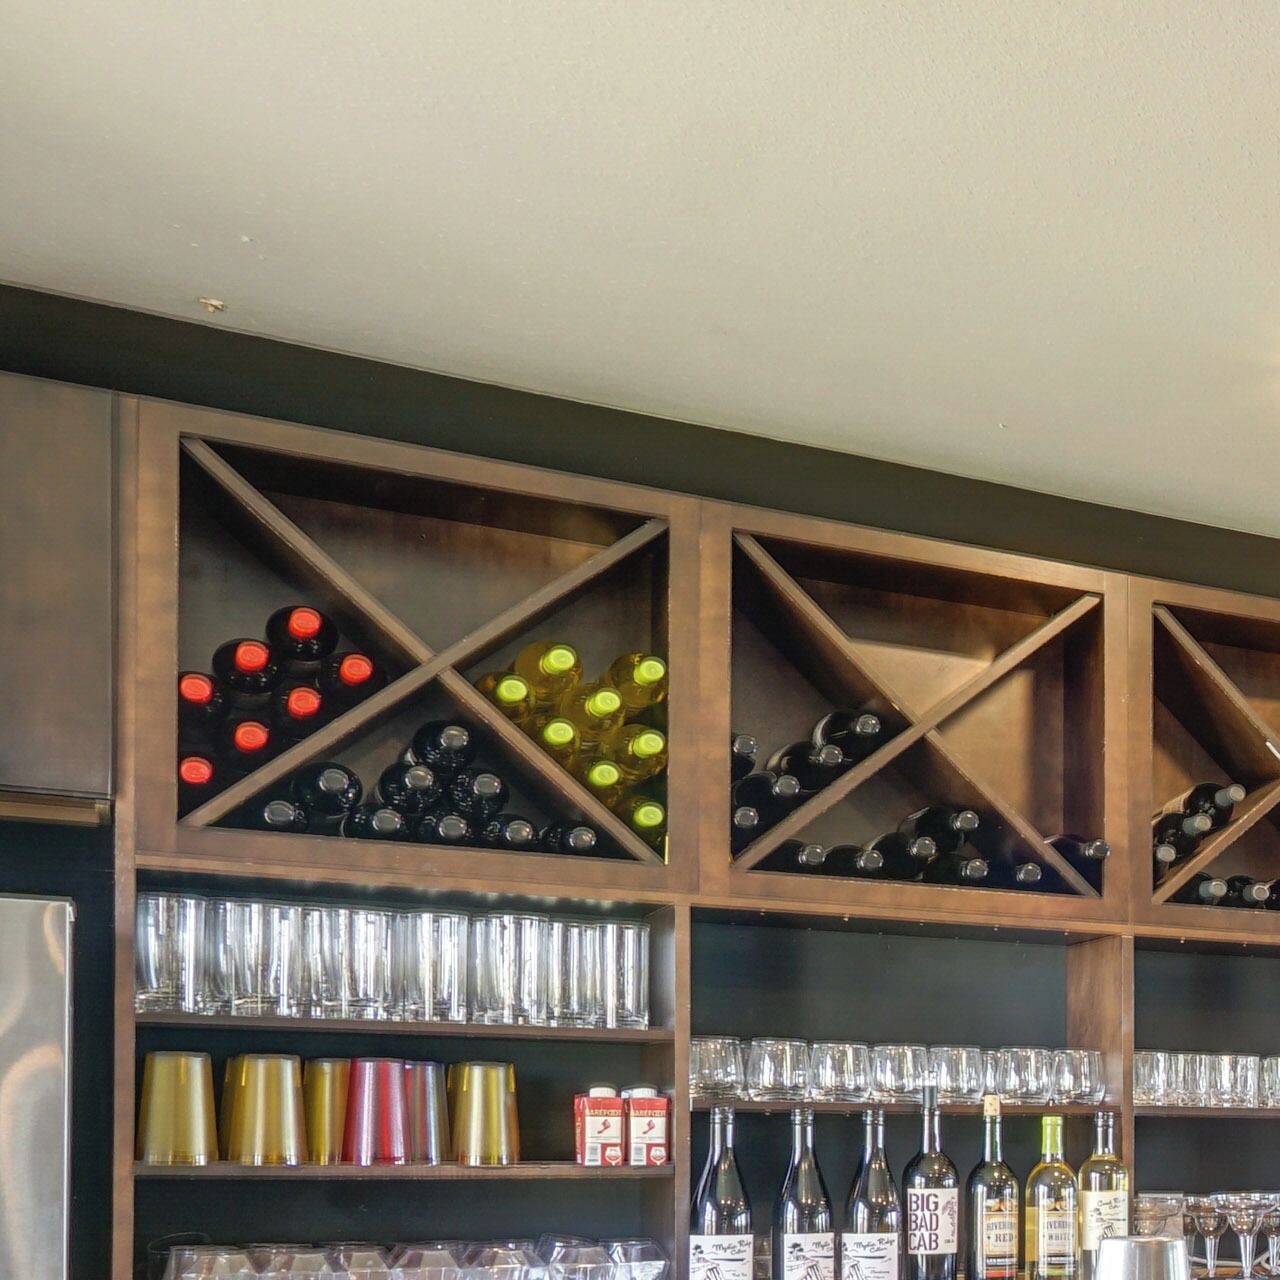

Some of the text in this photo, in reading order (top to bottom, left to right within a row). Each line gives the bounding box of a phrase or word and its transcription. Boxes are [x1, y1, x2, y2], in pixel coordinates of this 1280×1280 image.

[908, 1193, 939, 1212] BIG
[908, 1212, 939, 1232] BAD
[908, 1232, 939, 1251] CAB
[995, 1233, 1014, 1244] RED
